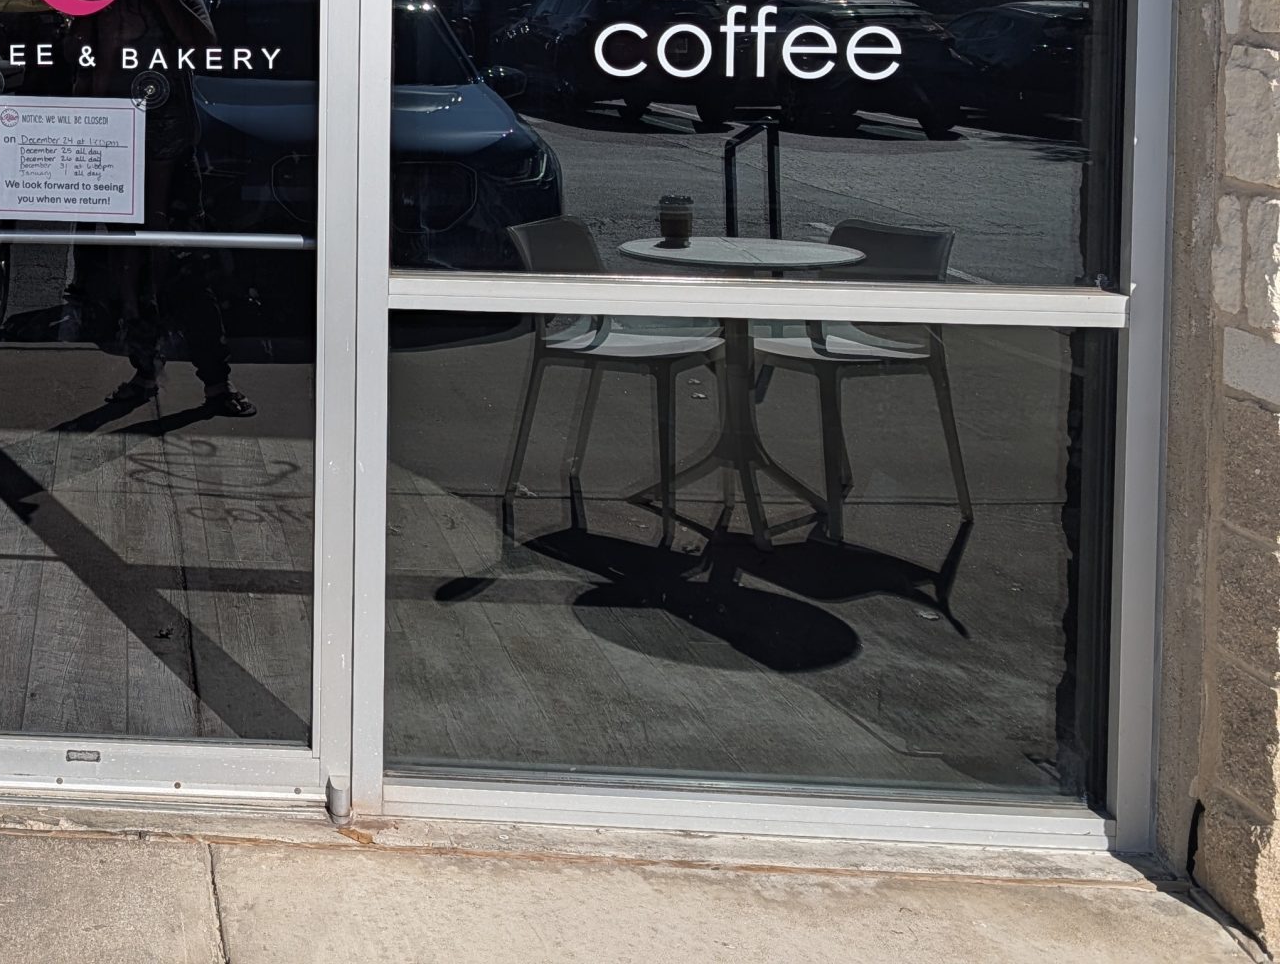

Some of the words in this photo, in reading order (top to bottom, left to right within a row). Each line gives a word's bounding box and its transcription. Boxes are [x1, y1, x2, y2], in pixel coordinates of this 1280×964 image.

[594, 5, 903, 81] coffee
[78, 45, 97, 67] &
[121, 47, 282, 70] BAKERY
[57, 115, 72, 125] WILL
[3, 136, 17, 144] on
[20, 134, 61, 145] December
[62, 136, 74, 145] 24
[20, 146, 58, 155] December
[75, 147, 87, 155] all
[88, 148, 102, 158] day
[20, 155, 57, 165] December
[4, 179, 20, 189] We
[22, 180, 42, 190] look
[44, 181, 80, 191] forward
[81, 182, 92, 191] to
[93, 183, 124, 194] seeing
[17, 196, 35, 206] you
[36, 194, 62, 204] when
[63, 197, 78, 205] we
[78, 196, 111, 206] return!
